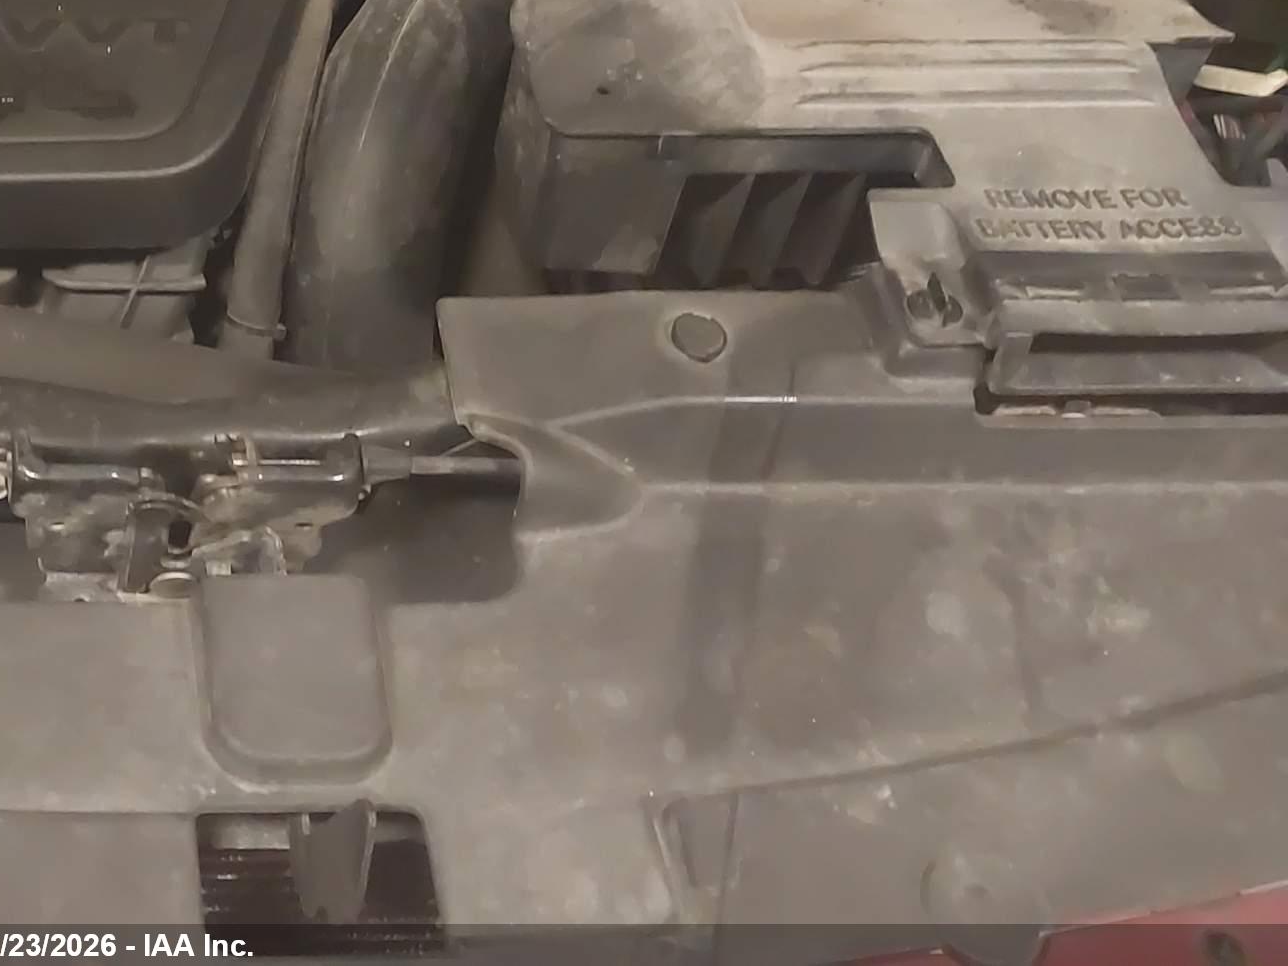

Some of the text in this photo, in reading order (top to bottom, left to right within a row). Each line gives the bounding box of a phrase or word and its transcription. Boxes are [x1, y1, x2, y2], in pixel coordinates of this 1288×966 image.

[4, 17, 191, 48] VVT
[983, 187, 1190, 210] REMOVE FOR
[974, 216, 1243, 241] BATTERY ACCESS
